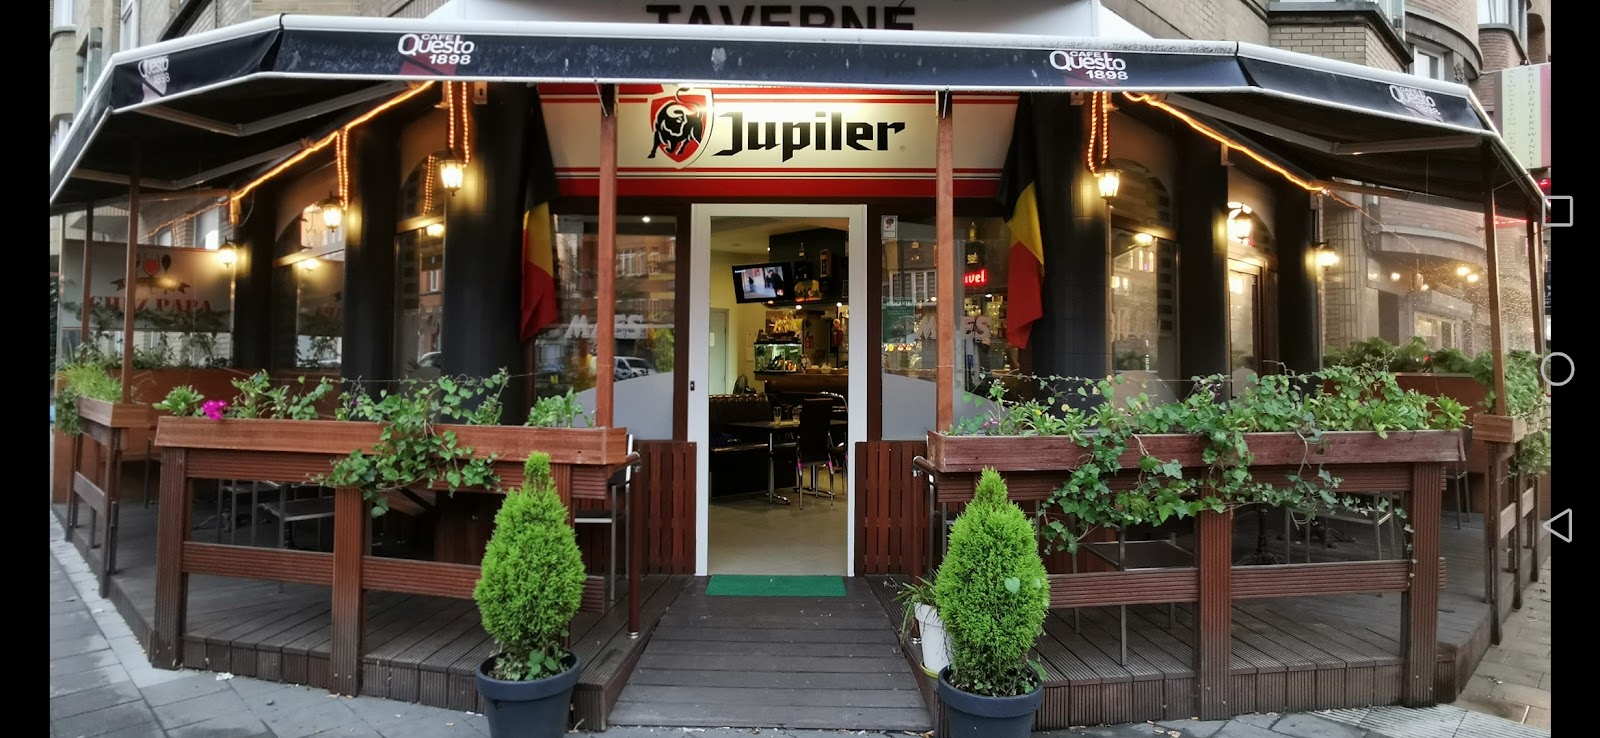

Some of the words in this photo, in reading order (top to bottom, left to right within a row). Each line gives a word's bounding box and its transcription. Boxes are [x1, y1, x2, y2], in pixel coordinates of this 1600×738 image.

[646, 4, 916, 31] TAVERNE
[397, 33, 475, 56] Questo
[429, 53, 471, 65] 1898
[1049, 50, 1126, 71] Questo
[1085, 69, 1129, 80] 1898
[711, 111, 906, 163] Jupiler
[564, 314, 645, 339] MES
[913, 315, 992, 340] MES
